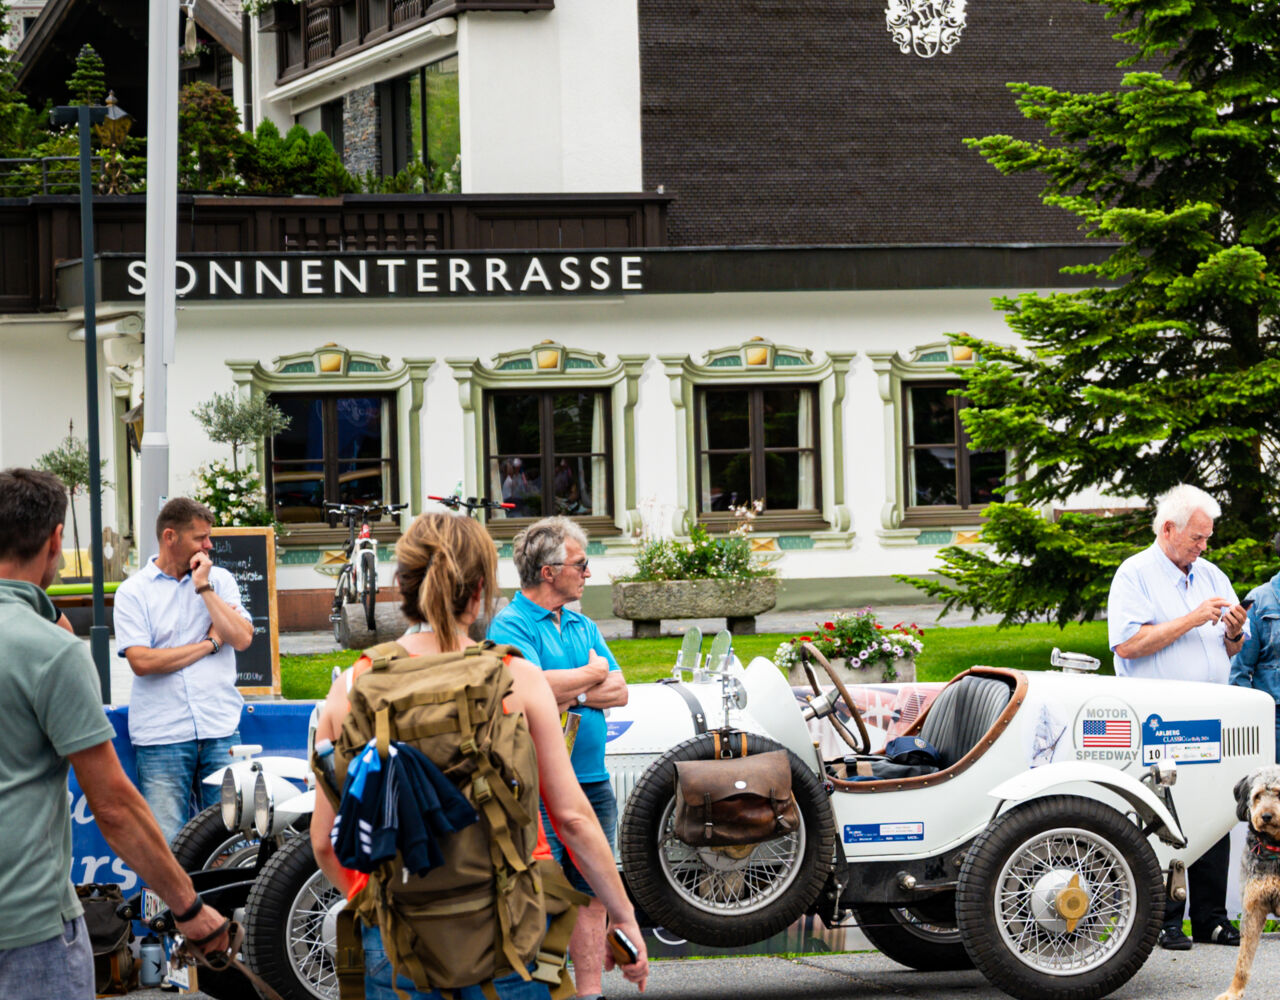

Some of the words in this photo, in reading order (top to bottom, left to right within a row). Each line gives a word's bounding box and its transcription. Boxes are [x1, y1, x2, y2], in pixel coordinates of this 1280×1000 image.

[1086, 708, 1128, 718] MOTOR
[1075, 750, 1139, 761] SPEEDWAY
[1149, 749, 1161, 760] 10
